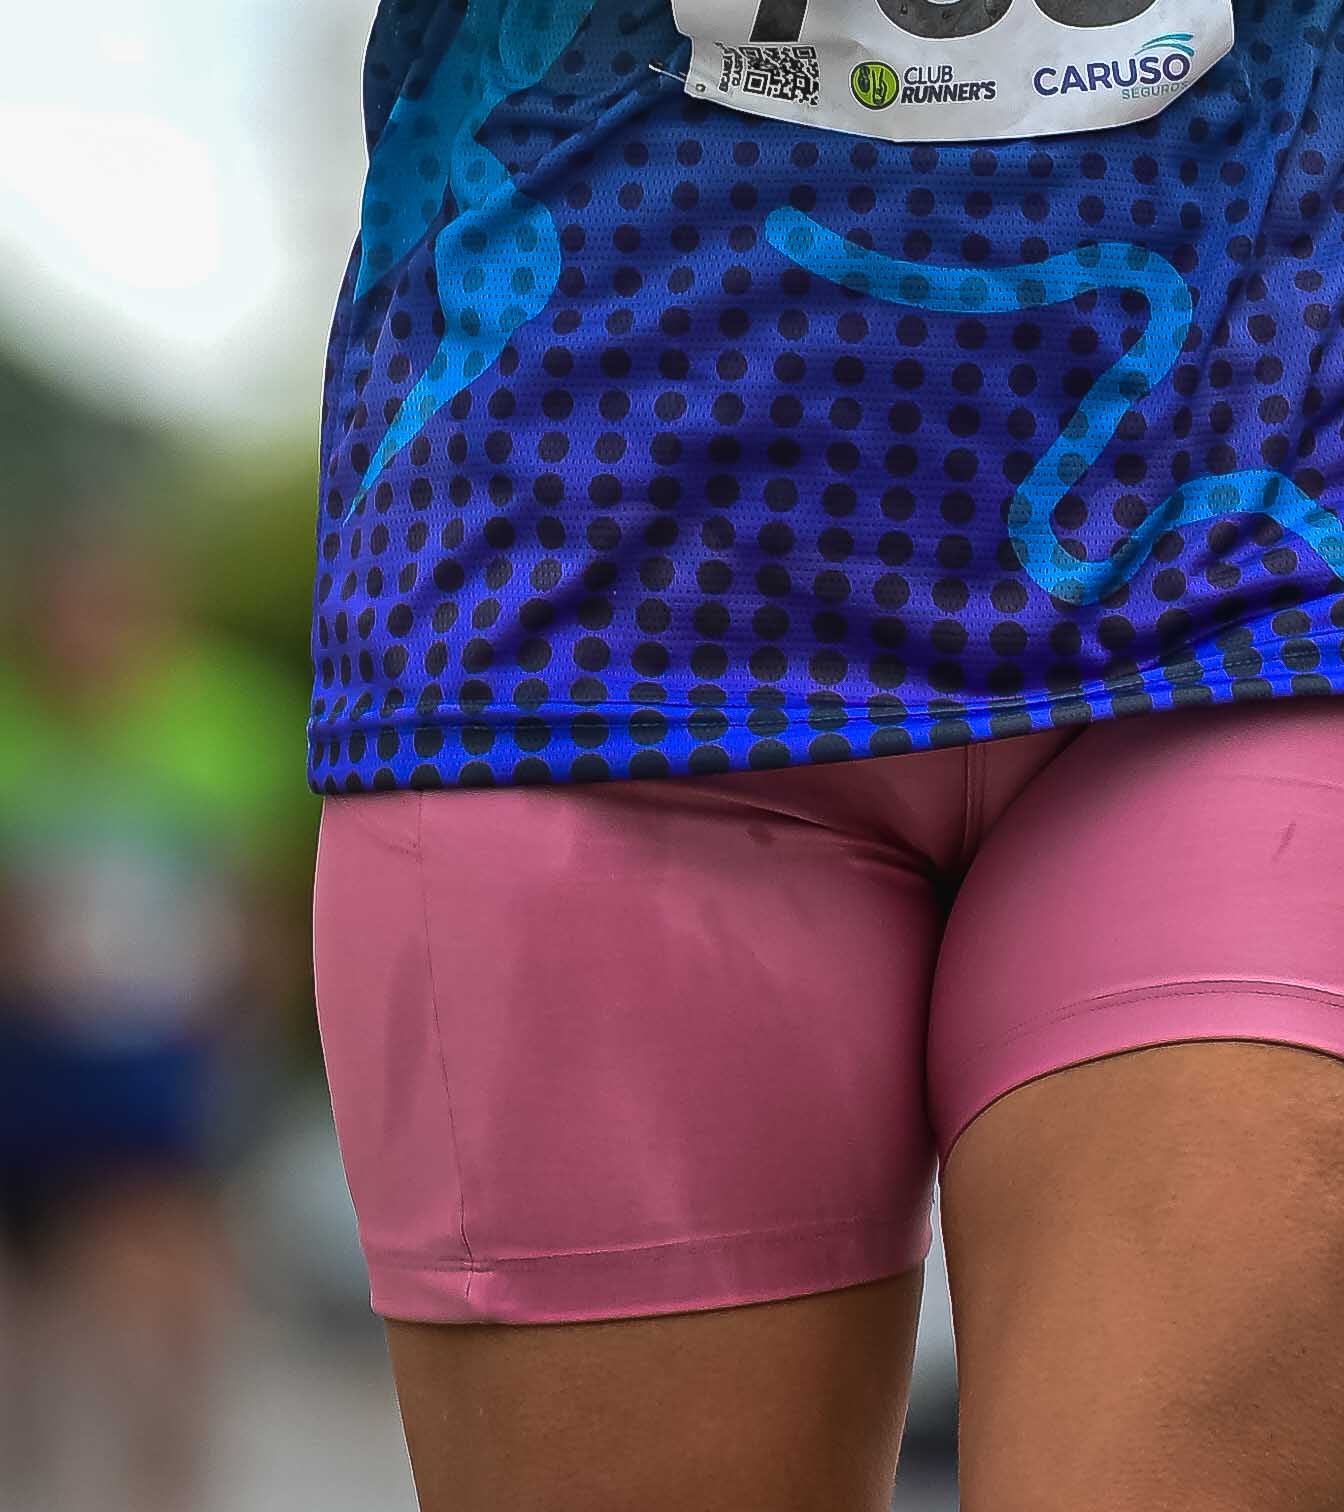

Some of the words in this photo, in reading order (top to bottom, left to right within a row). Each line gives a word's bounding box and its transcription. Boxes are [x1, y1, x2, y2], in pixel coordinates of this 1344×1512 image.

[903, 65, 954, 85] CLUB
[1033, 52, 1191, 97] CARUSO
[900, 80, 997, 104] RUNNER'S
